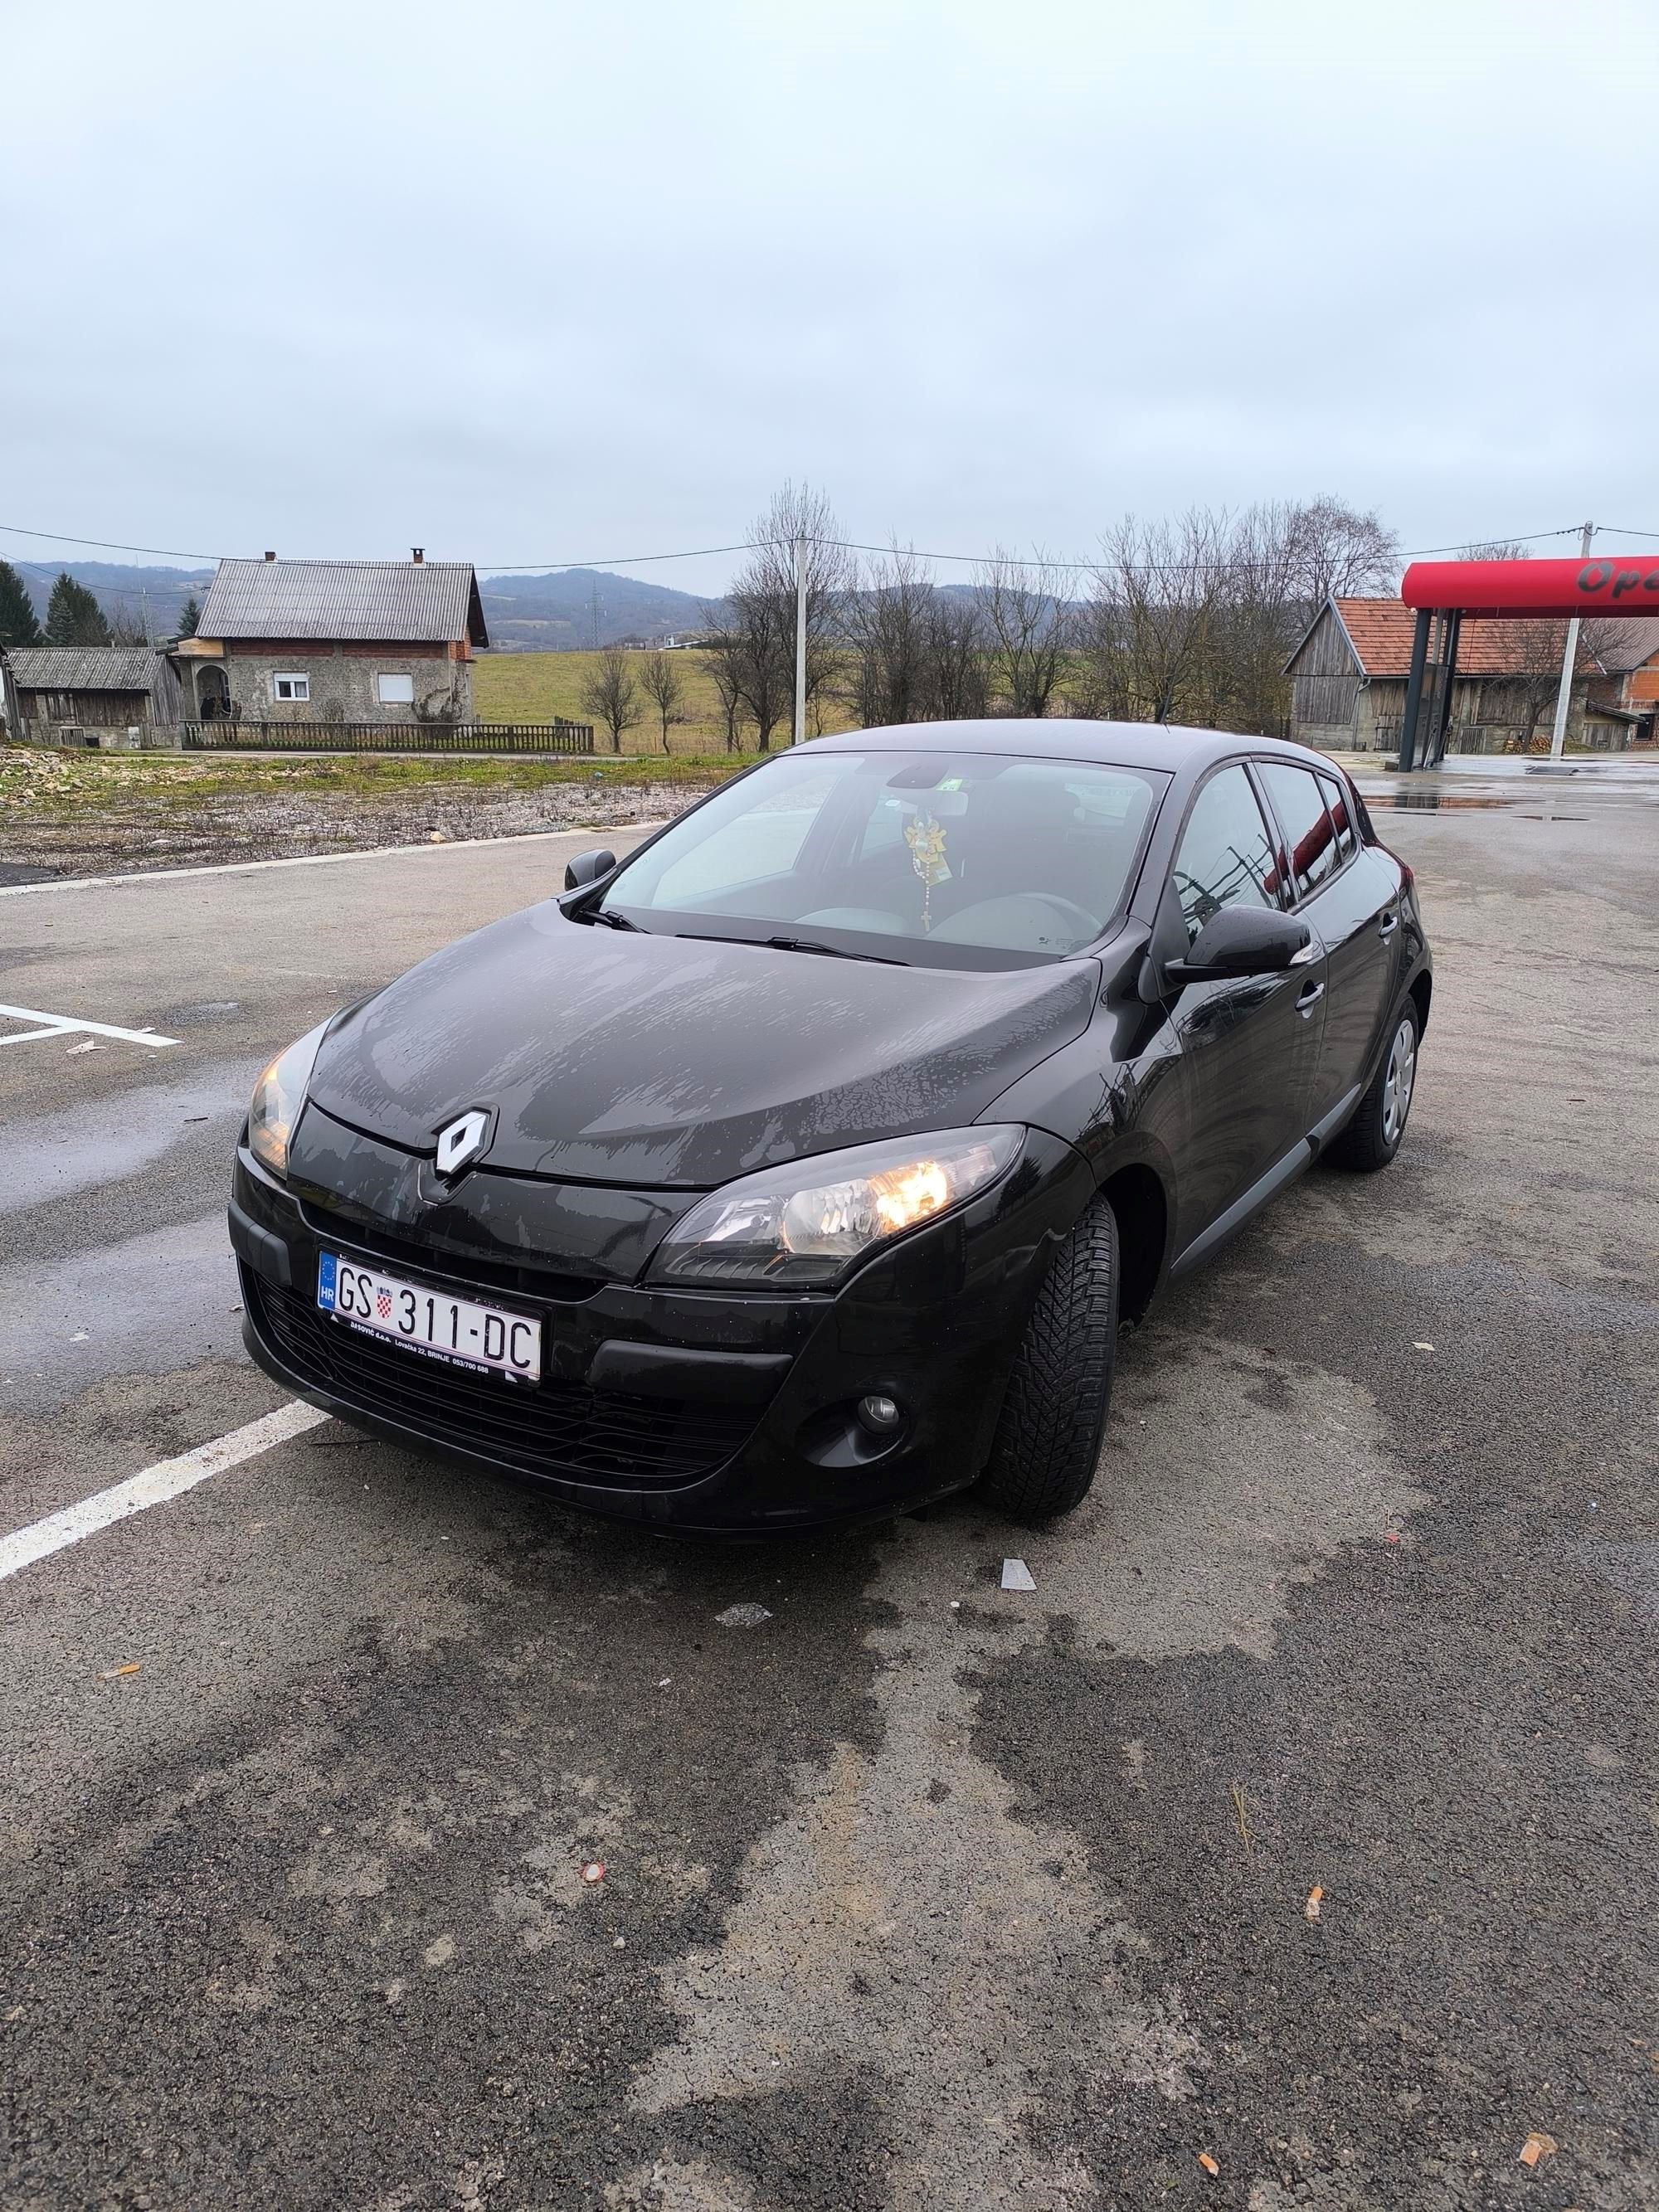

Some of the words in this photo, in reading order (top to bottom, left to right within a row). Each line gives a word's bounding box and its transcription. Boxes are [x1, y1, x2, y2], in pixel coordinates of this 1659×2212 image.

[320, 1286, 335, 1302] HR
[338, 1266, 373, 1320] GS
[397, 1289, 532, 1369] 311-DC
[375, 1332, 392, 1344] d.o.o.
[427, 1350, 450, 1363] BRINJE
[452, 1358, 476, 1370] 053/700
